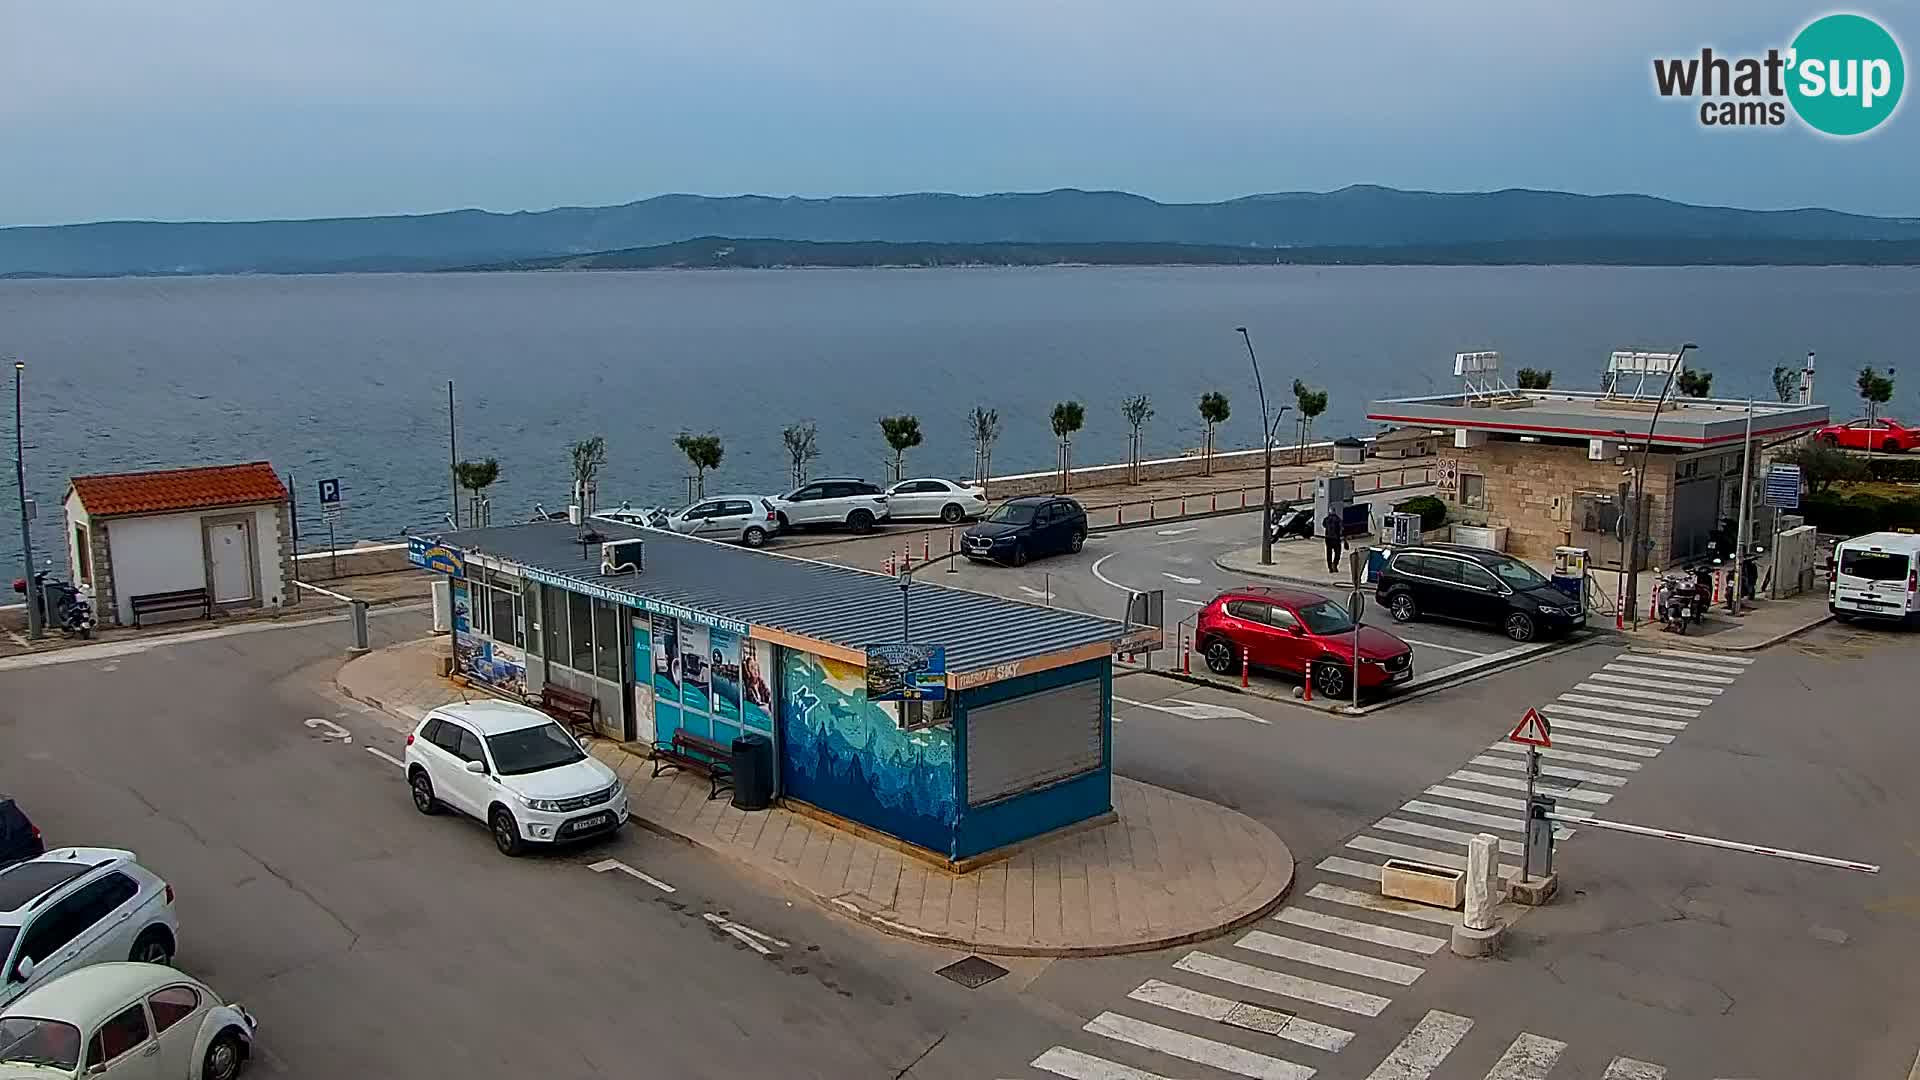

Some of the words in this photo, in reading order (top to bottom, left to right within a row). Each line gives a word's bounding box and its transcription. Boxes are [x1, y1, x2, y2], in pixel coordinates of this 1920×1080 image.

[323, 482, 335, 500] P
[605, 591, 636, 606] POSTAJA
[645, 601, 660, 611] BUS
[660, 604, 692, 620] STATION
[693, 612, 719, 629] TICKET
[720, 619, 746, 634] OFFICE
